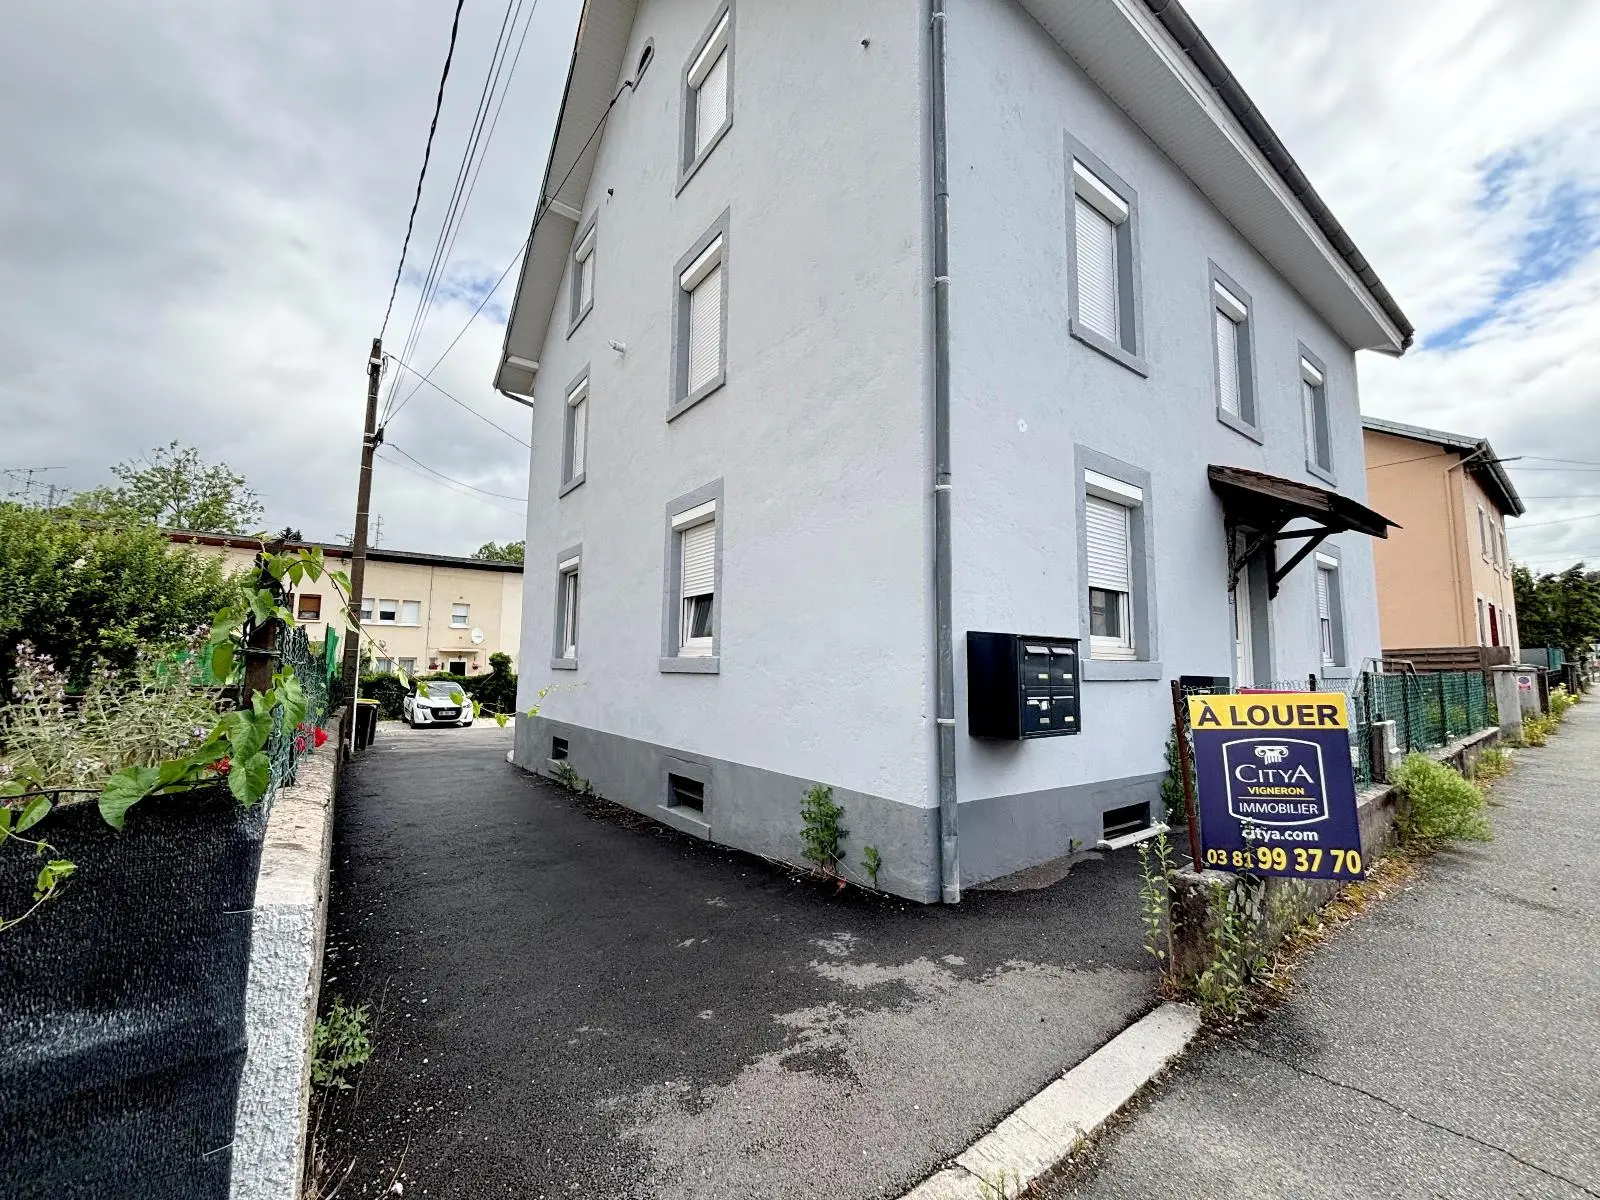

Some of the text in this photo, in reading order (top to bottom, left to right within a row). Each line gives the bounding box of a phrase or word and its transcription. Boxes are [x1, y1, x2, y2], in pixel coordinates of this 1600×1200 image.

[1198, 699, 1341, 727] À LOUER
[1248, 786, 1305, 796] VIGNERON
[1239, 802, 1319, 815] IMMOBILIER
[1206, 849, 1228, 866] 03
[1257, 846, 1288, 871] 99
[1294, 848, 1325, 873] 37
[1330, 849, 1362, 874] 70
